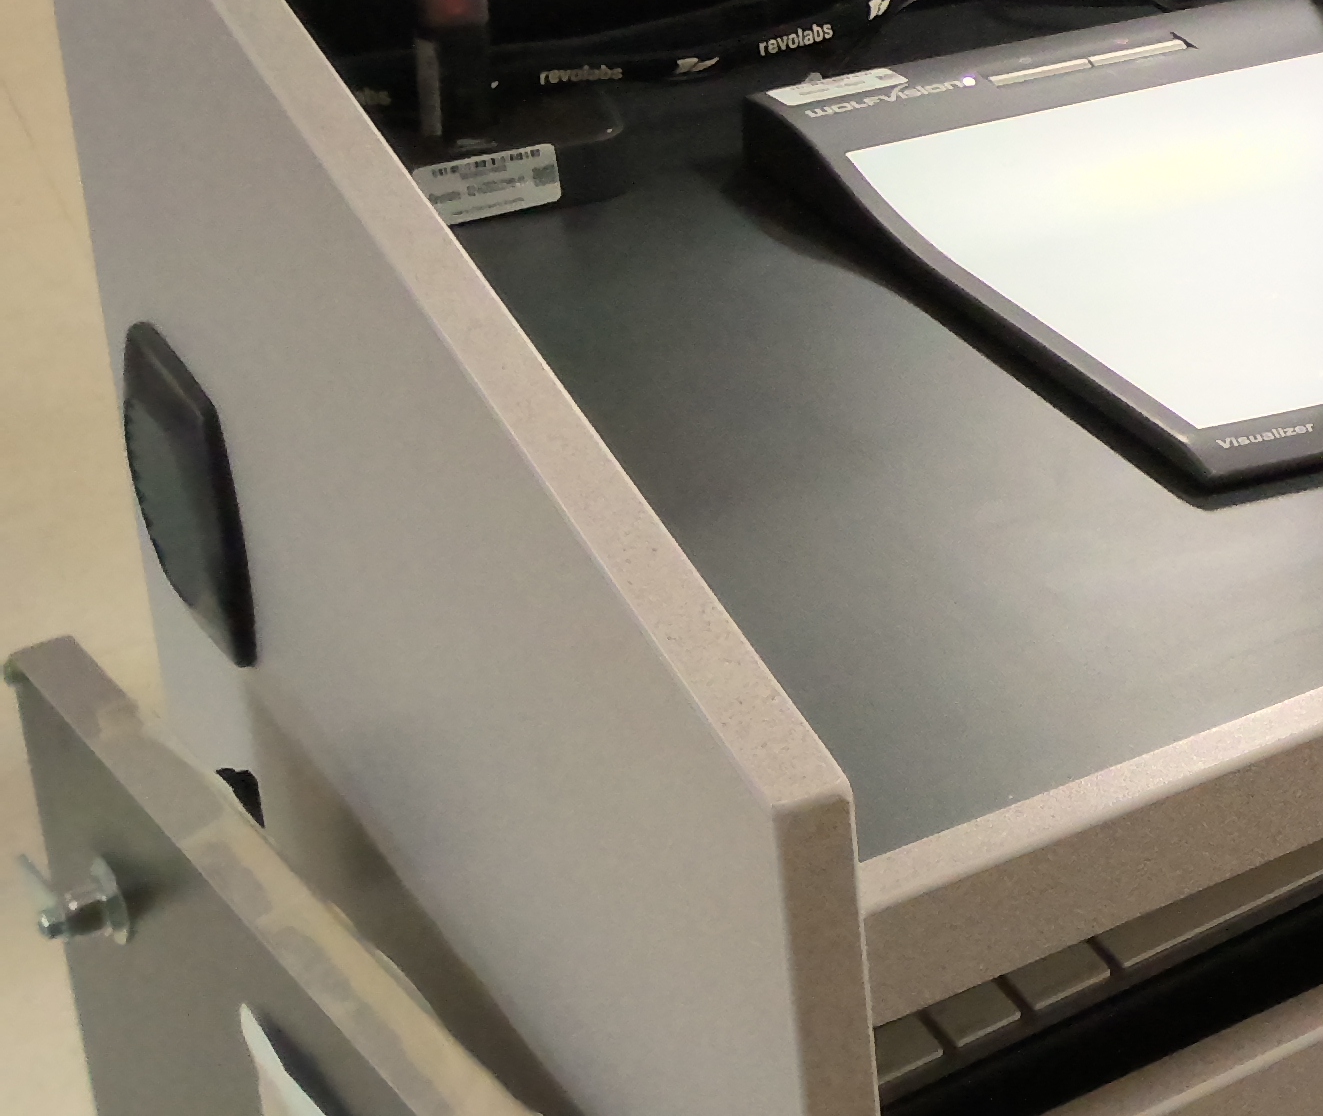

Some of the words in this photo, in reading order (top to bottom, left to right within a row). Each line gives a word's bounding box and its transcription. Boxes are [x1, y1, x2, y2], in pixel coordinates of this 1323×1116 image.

[758, 22, 834, 57] revolabs
[539, 64, 623, 86] revolabs
[1215, 423, 1315, 450] Visualizer
